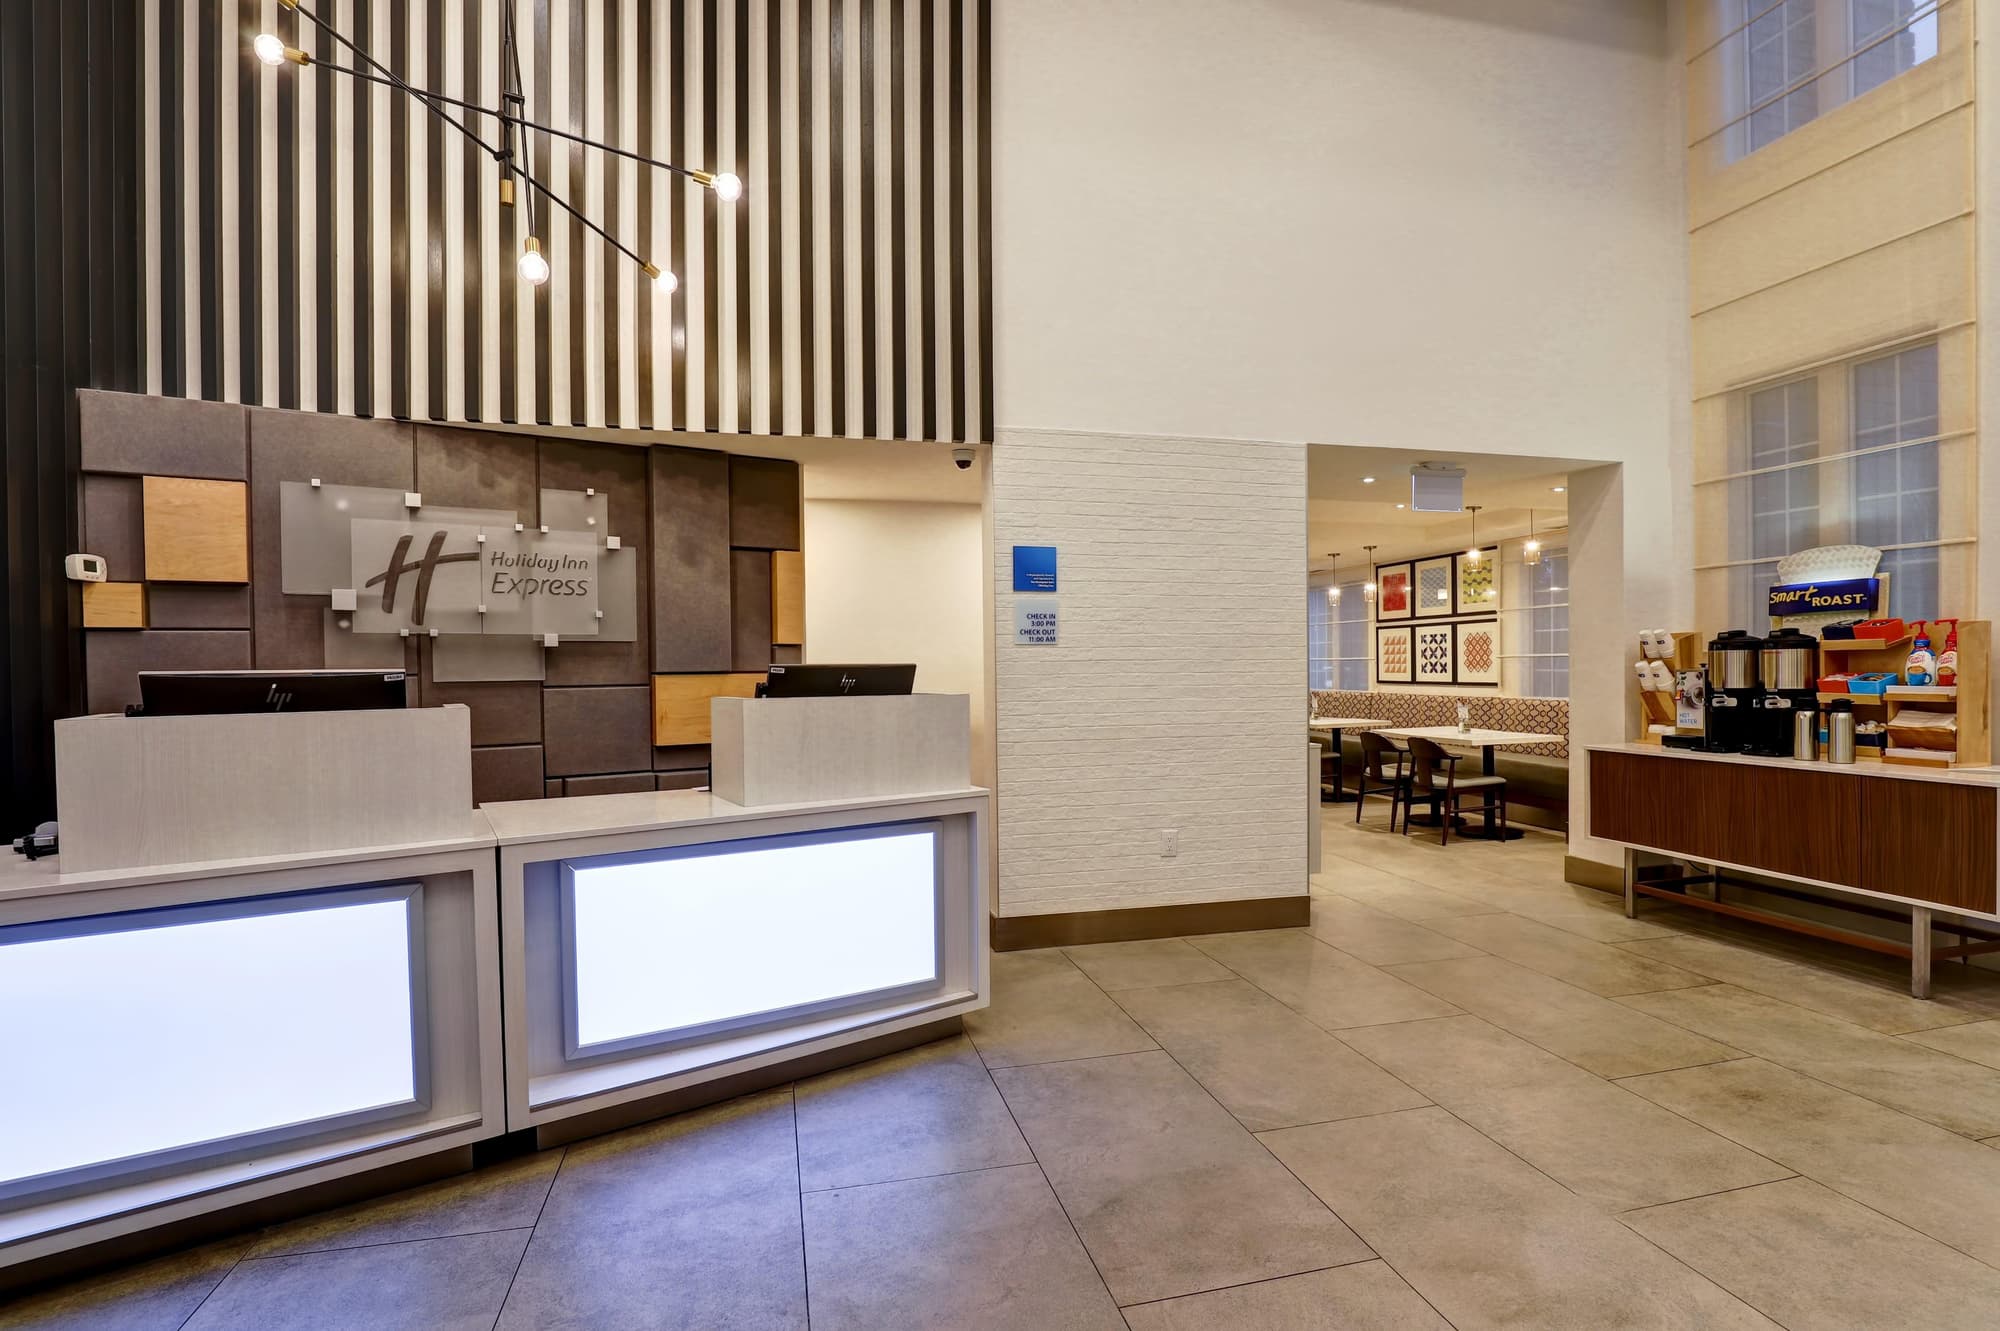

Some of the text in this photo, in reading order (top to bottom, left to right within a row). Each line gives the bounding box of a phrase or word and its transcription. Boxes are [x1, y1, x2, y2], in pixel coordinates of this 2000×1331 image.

[491, 551, 589, 573] Holiday Inn
[491, 572, 589, 600] Express
